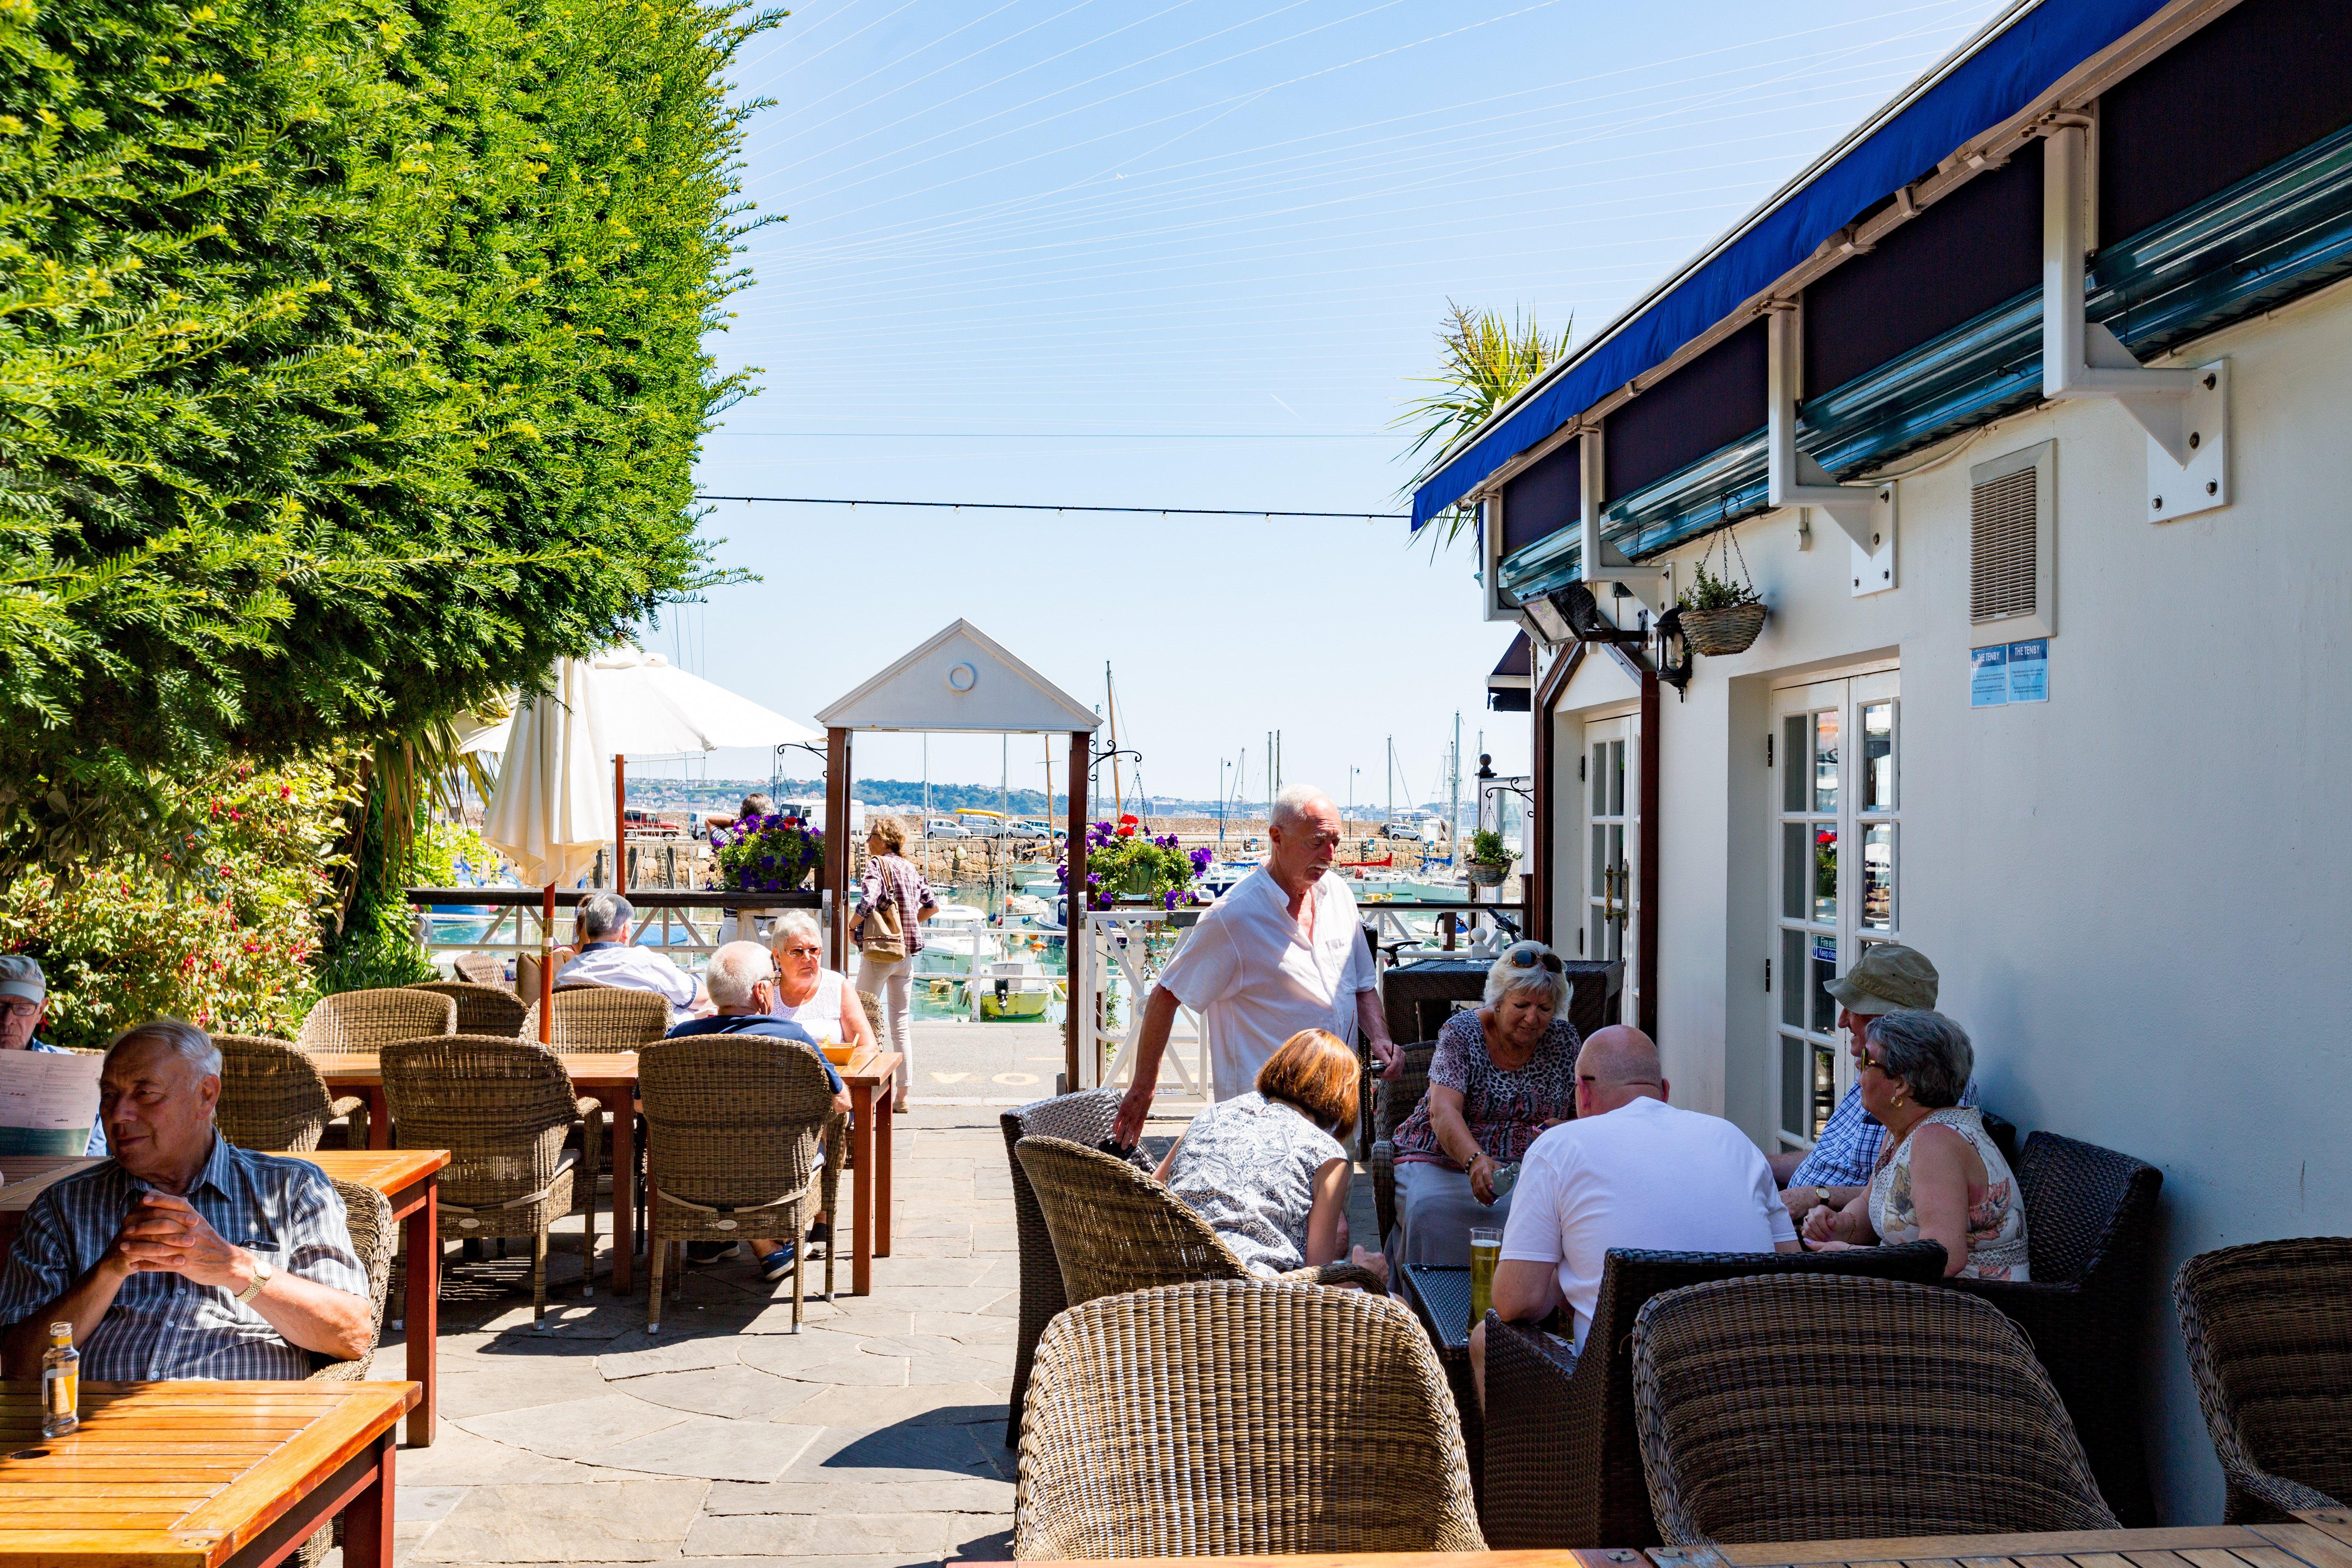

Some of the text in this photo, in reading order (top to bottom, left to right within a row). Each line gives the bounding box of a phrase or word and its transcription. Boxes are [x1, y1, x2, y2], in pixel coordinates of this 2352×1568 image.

[1986, 651, 2000, 661] TENBY
[2015, 645, 2040, 656] THE TENBY
[1819, 948, 1828, 959] Keep
